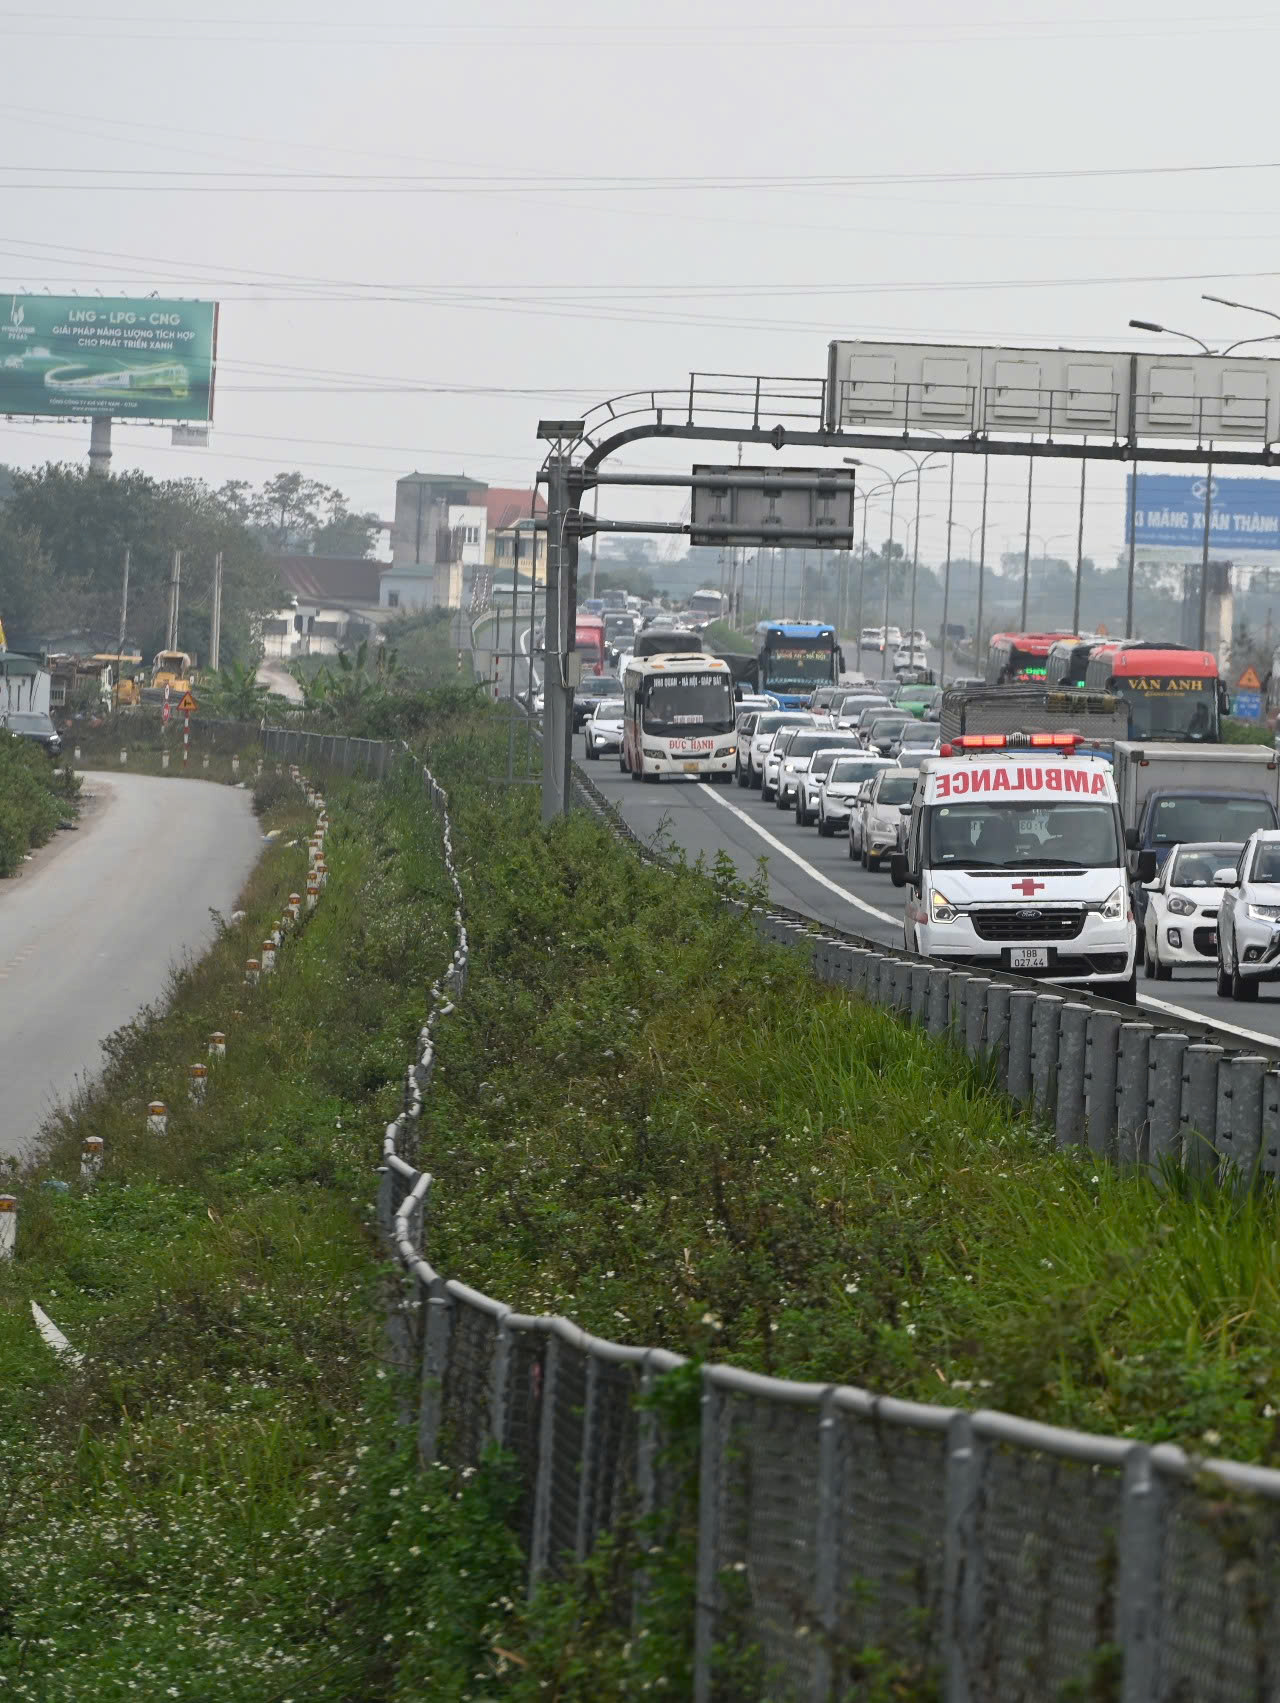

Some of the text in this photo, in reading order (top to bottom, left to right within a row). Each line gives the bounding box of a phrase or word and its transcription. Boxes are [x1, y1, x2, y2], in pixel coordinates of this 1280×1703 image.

[68, 310, 181, 325] LNG LPG CNG
[78, 338, 98, 347] CHO
[150, 341, 173, 350] XANH
[1147, 507, 1189, 528] MĂNG
[1233, 512, 1279, 532] THÀNH
[1128, 677, 1203, 690] VÂN ANH
[1021, 949, 1038, 958] 18B
[1014, 959, 1045, 967] 027.44
